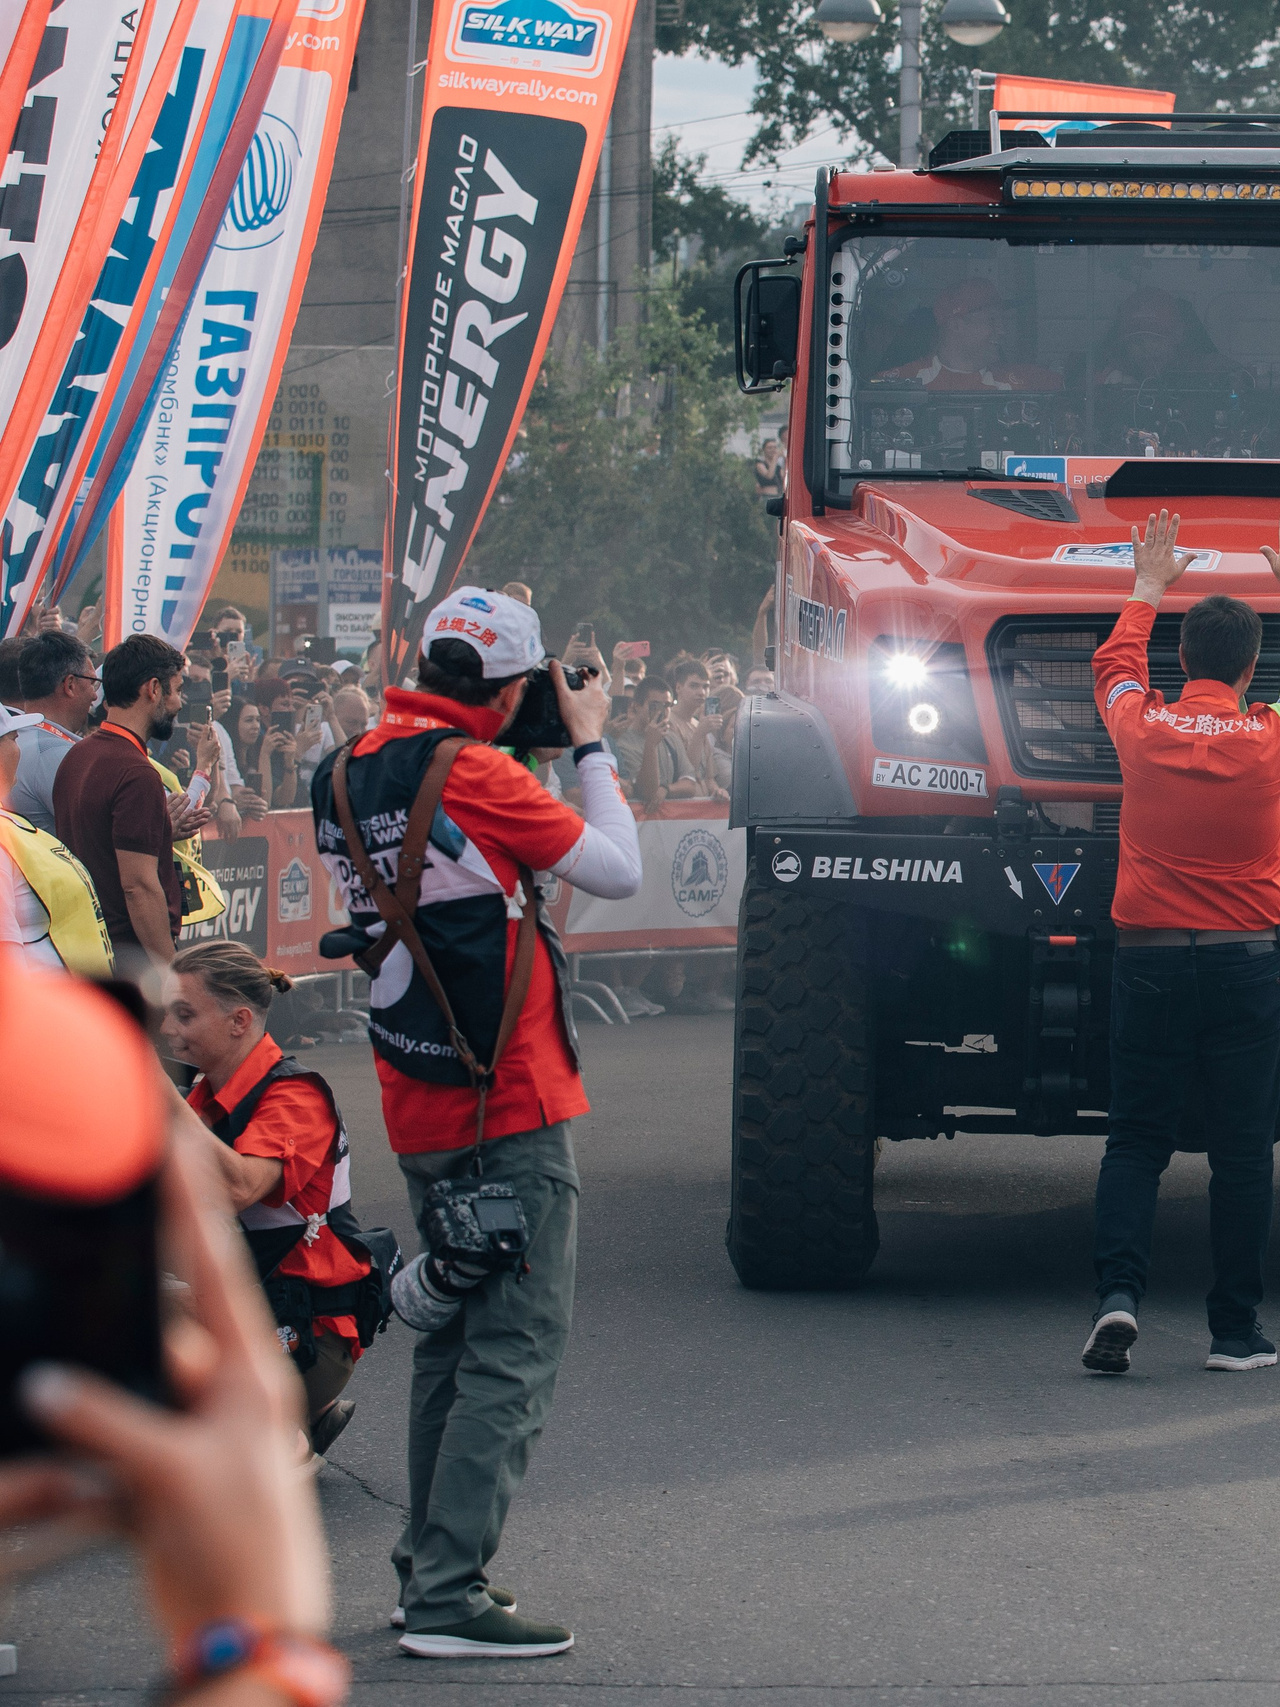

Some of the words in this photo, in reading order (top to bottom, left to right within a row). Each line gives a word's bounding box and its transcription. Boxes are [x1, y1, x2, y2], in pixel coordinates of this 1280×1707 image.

[465, 12, 533, 35] SILK
[534, 19, 596, 42] WAY
[492, 32, 561, 48] RALLY
[438, 70, 598, 106] silkwayrally.com
[414, 272, 453, 482] МОТОРНОЕ
[875, 773, 886, 782] BY
[891, 763, 922, 787] AC
[927, 767, 984, 794] 2000-7
[370, 808, 408, 831] SILK
[811, 856, 964, 884] BELSHINA
[678, 889, 719, 903] CAMF
